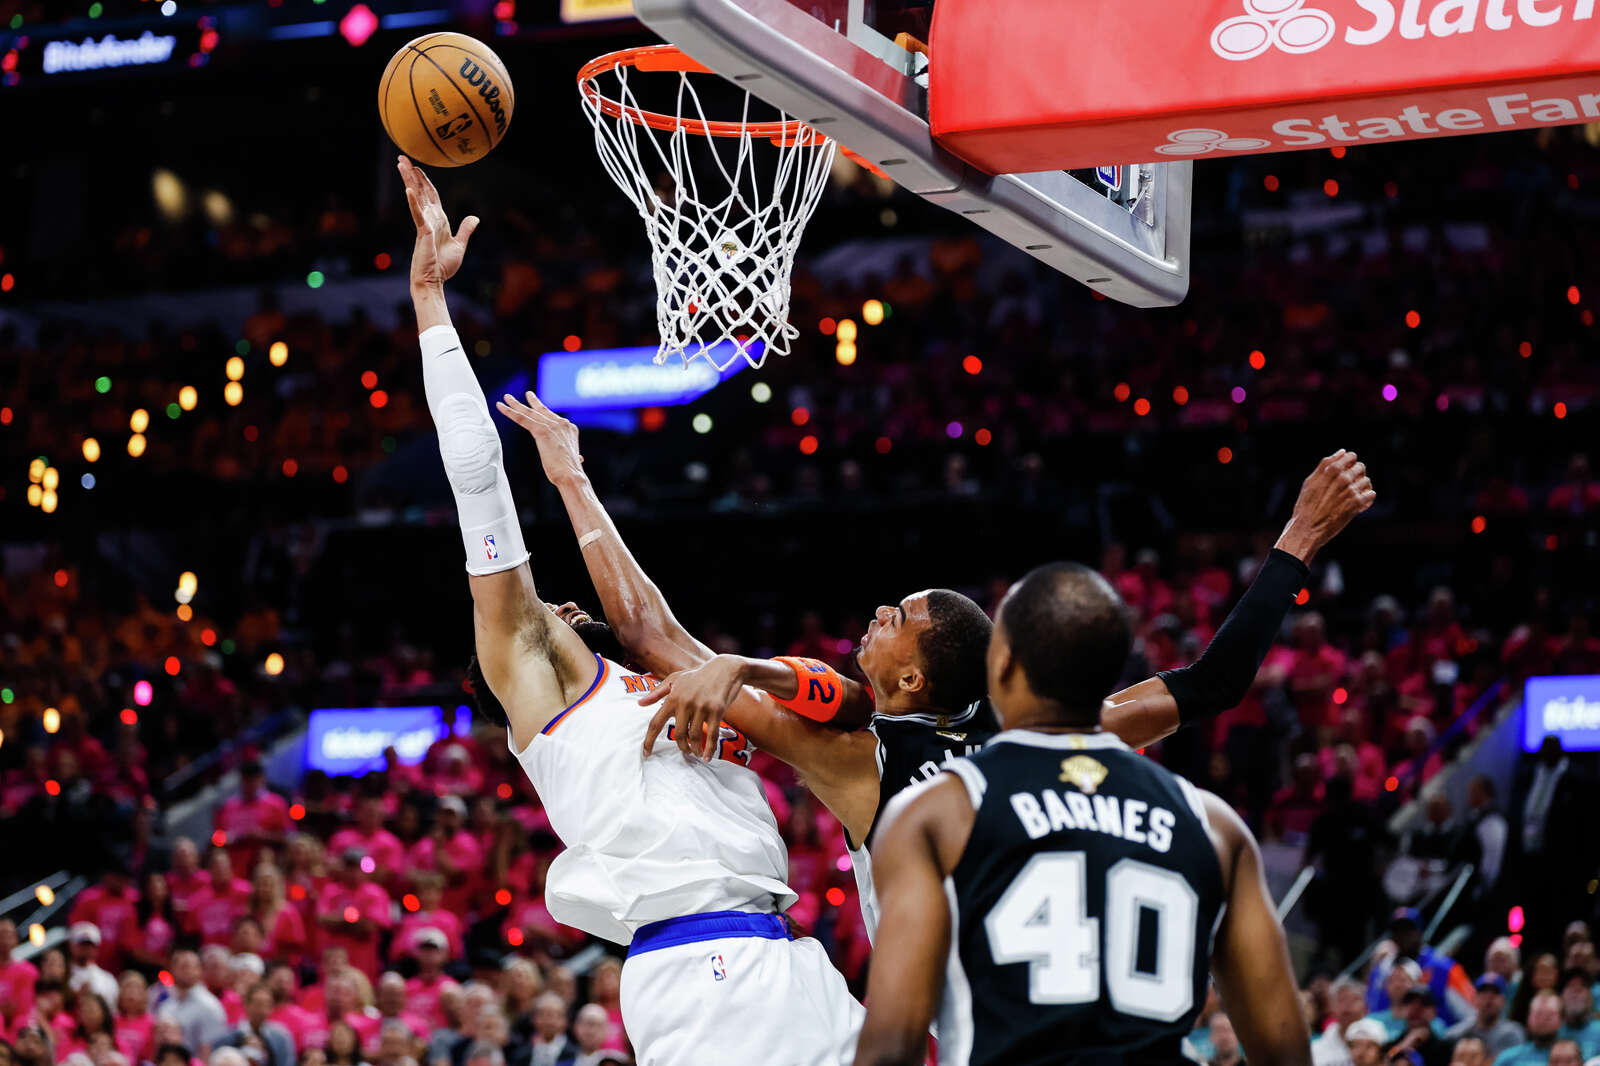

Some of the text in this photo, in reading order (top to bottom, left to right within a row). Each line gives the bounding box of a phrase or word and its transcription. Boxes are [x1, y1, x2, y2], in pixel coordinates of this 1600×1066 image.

[459, 57, 506, 137] Wilson
[1272, 104, 1483, 146] State
[1010, 789, 1176, 853] BARNES
[983, 850, 1200, 1023] 40
